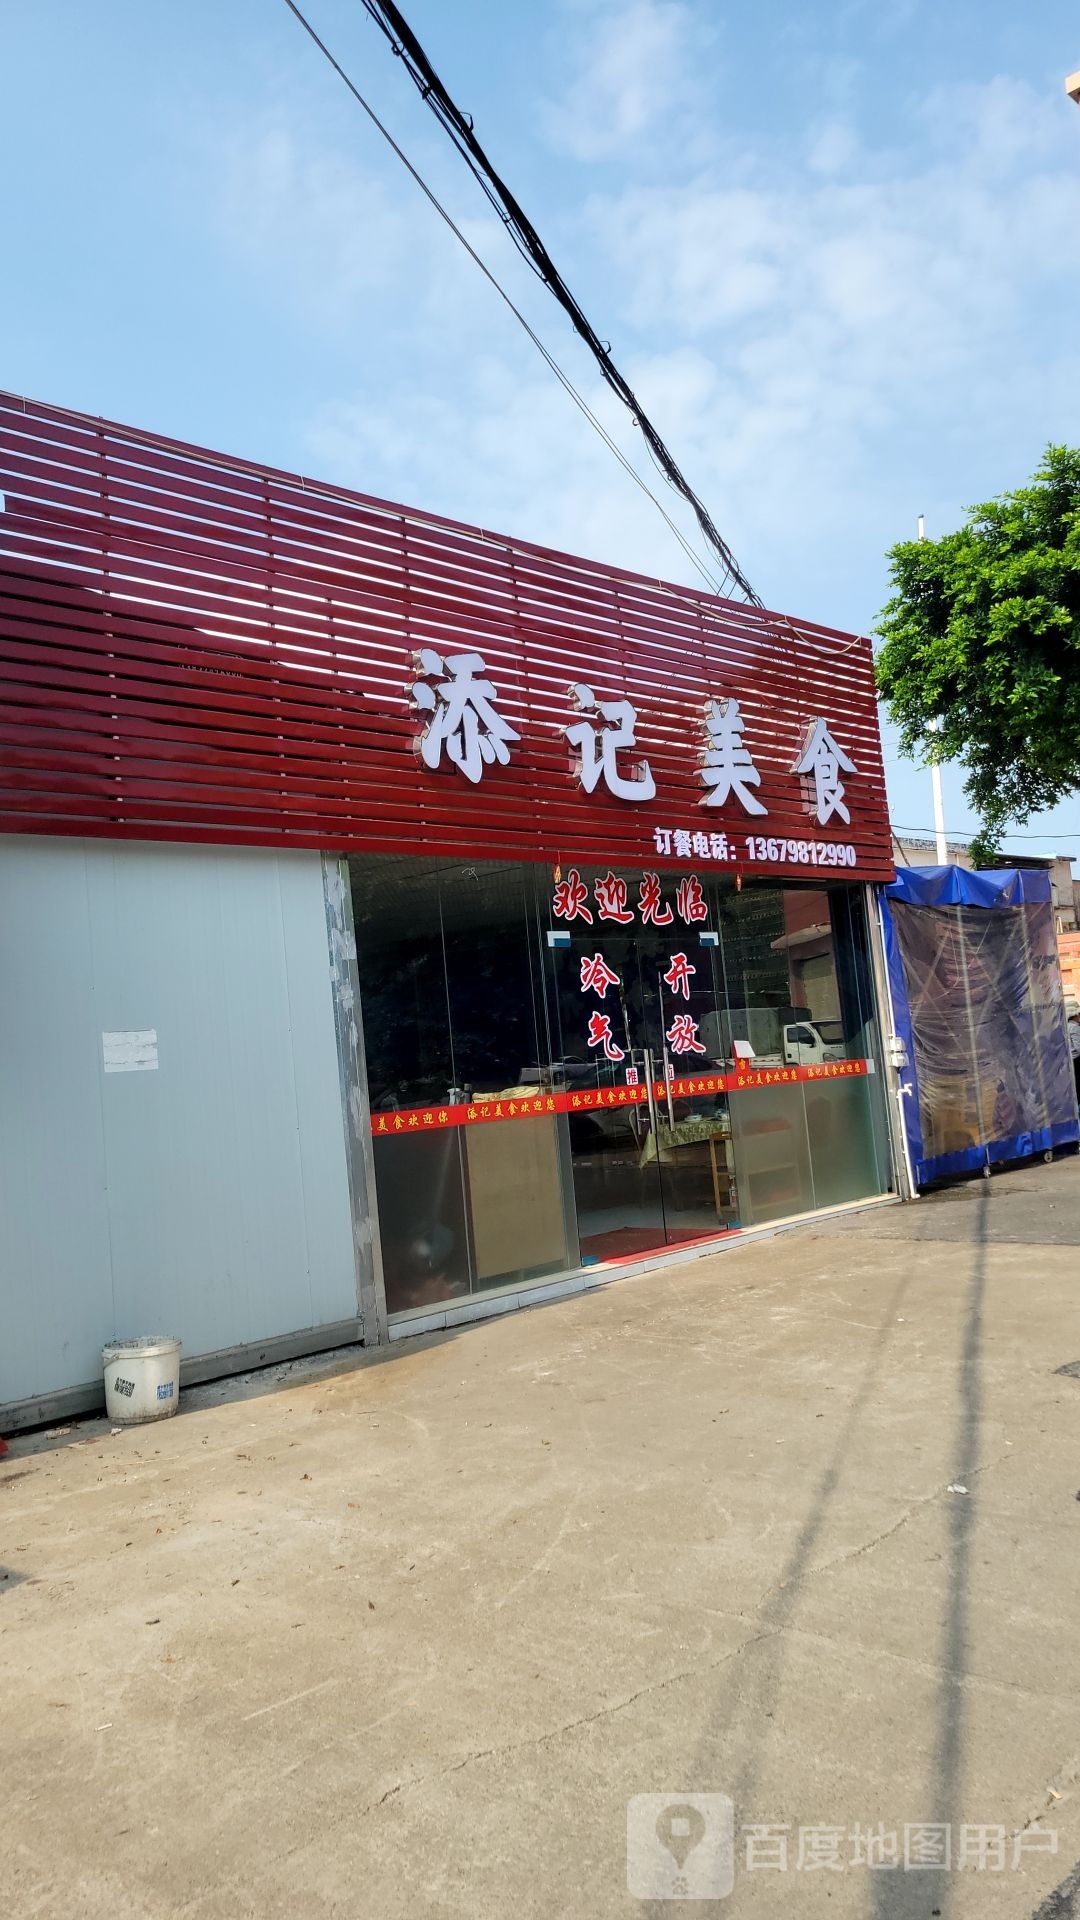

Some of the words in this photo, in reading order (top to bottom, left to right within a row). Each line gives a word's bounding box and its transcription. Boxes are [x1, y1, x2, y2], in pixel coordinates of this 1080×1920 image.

[409, 648, 857, 825] 添记美食
[552, 868, 708, 926] 欢迎光临
[580, 952, 624, 1062] 冷气
[664, 952, 707, 1055] 开放
[467, 1097, 556, 1120] 添记美食欢迎您
[626, 1068, 638, 1084] 推
